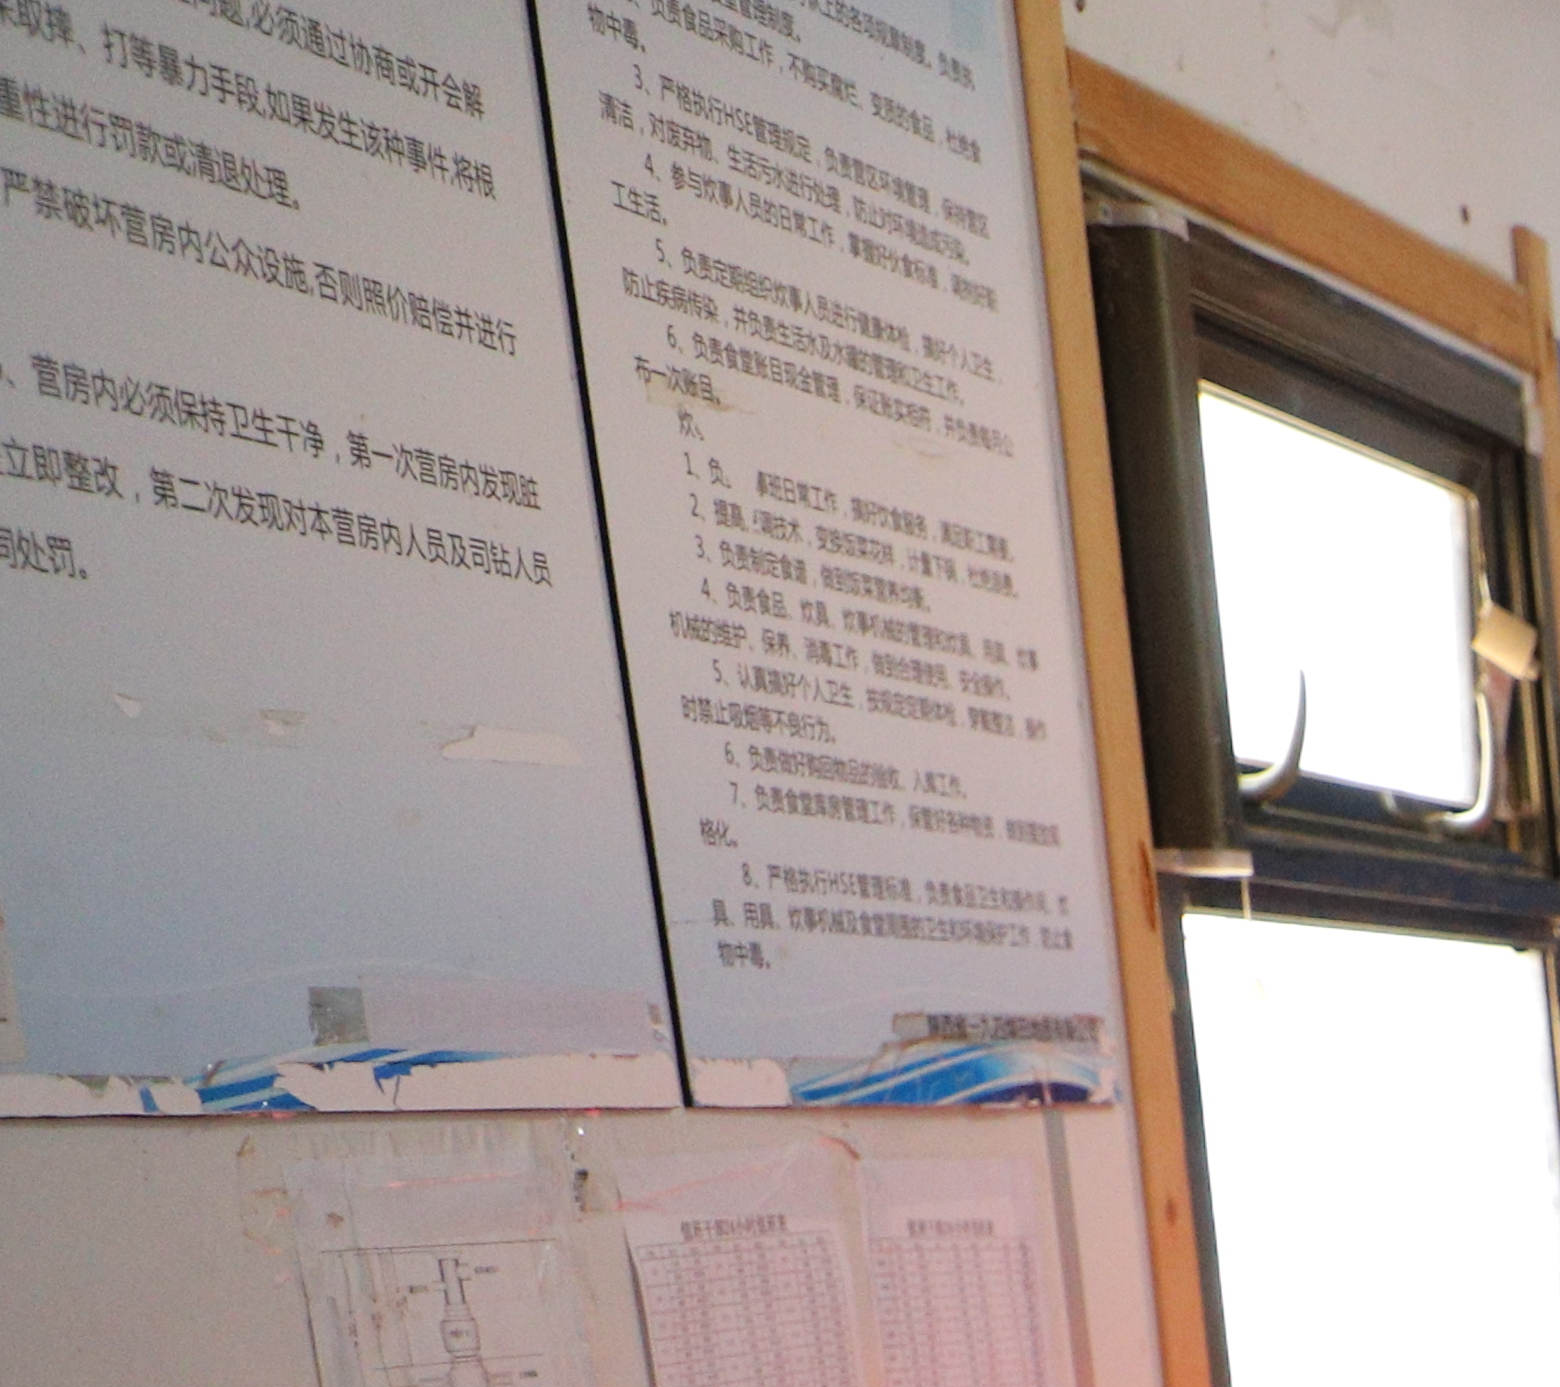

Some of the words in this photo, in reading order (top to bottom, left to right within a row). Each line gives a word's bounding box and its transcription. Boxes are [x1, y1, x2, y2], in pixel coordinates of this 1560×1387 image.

[0, 354, 541, 512] 、营房内必须保持卫生干净，第一次营房内发现脏
[0, 440, 553, 588] 立即整改，第二次发现对本营房内人员及司钻人员
